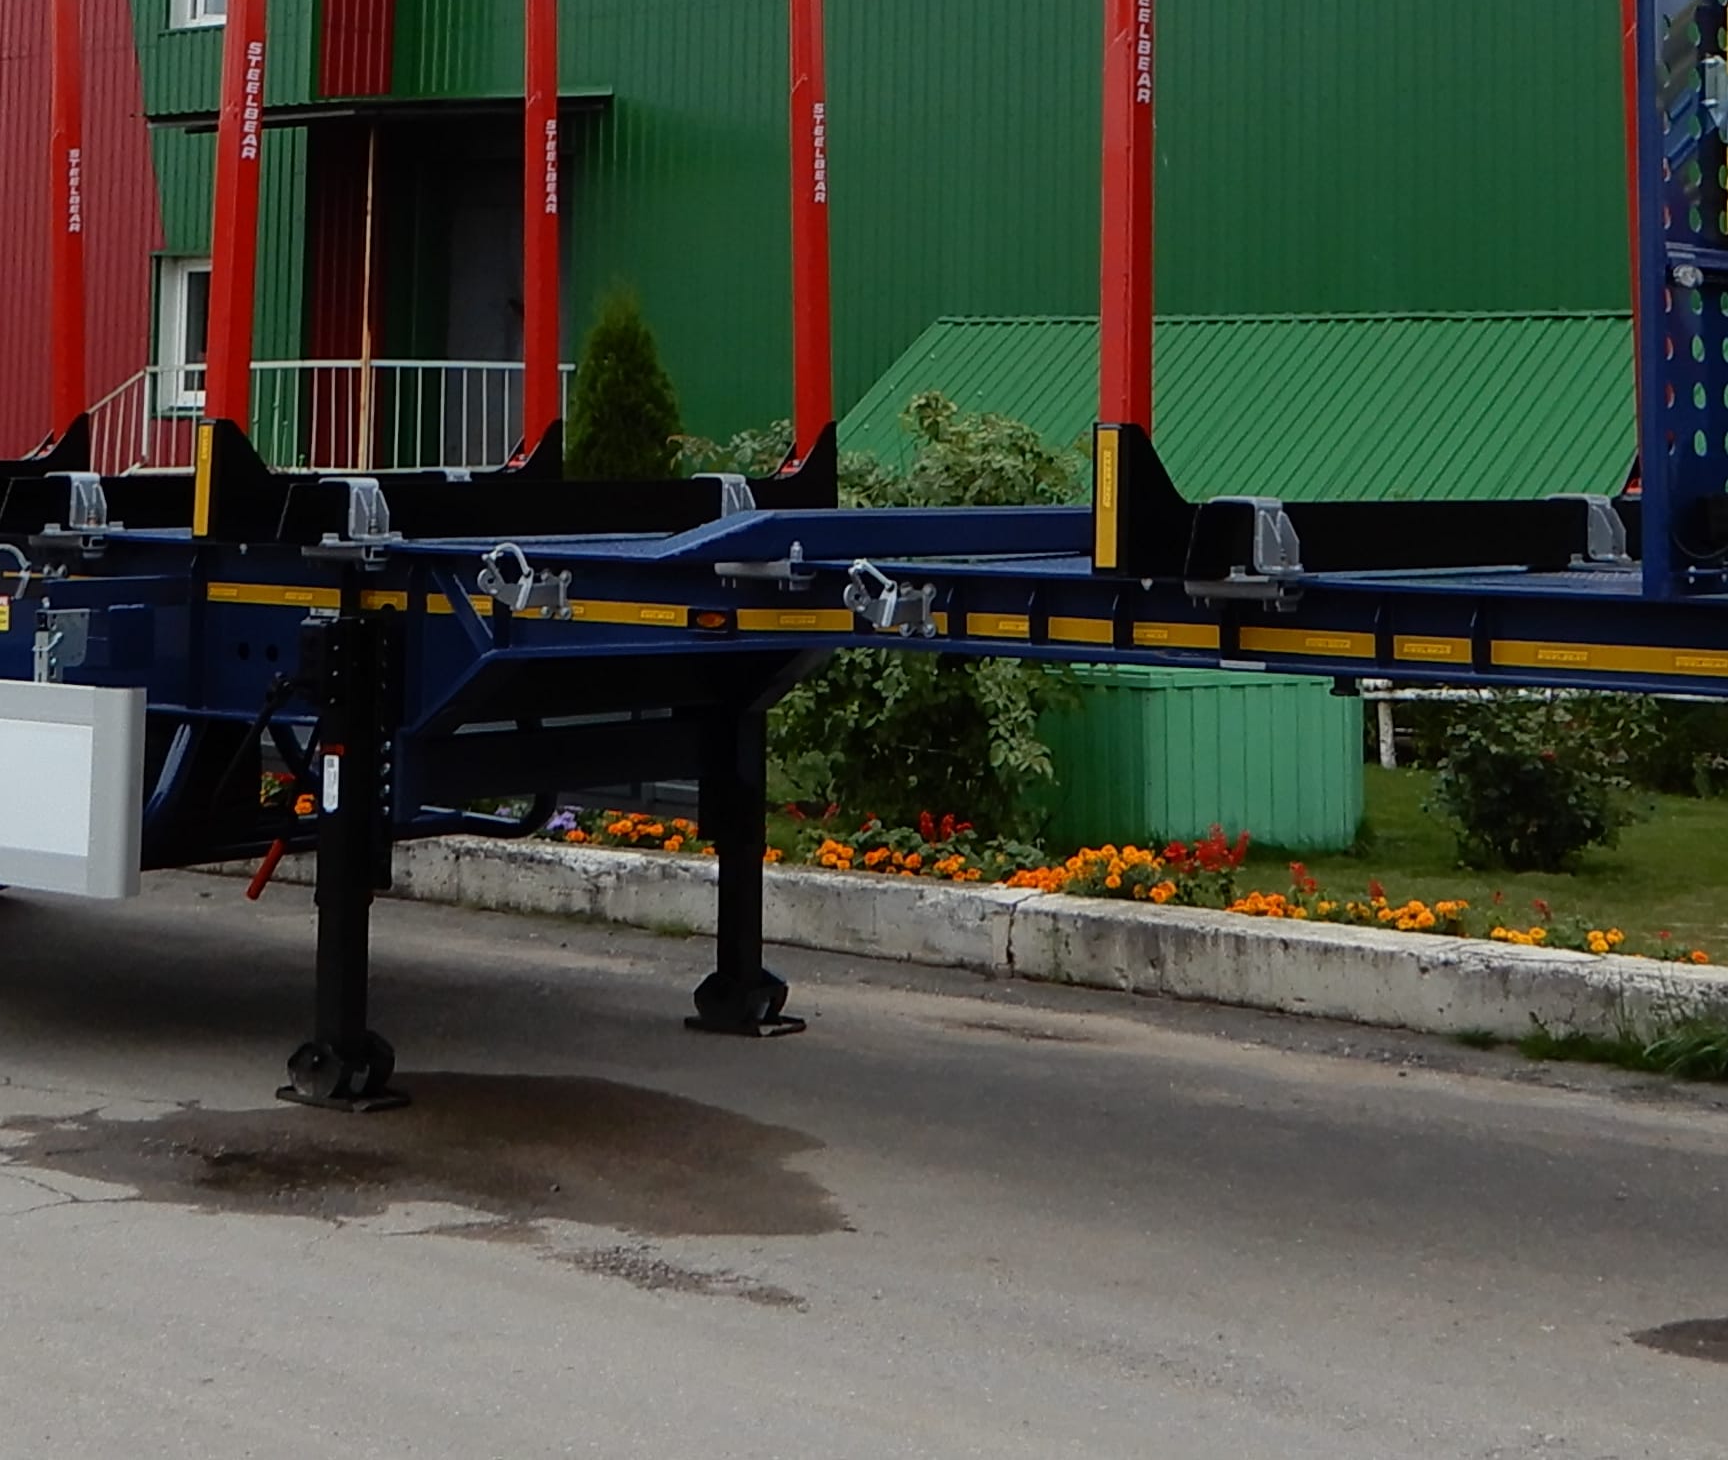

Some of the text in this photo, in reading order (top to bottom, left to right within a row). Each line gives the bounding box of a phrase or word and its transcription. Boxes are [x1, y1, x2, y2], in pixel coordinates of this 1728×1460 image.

[241, 42, 263, 160] STEELBEAR
[68, 149, 81, 233] STEELBEAR
[545, 119, 557, 214] STEELBEAR
[813, 103, 826, 204] STEELBEAR
